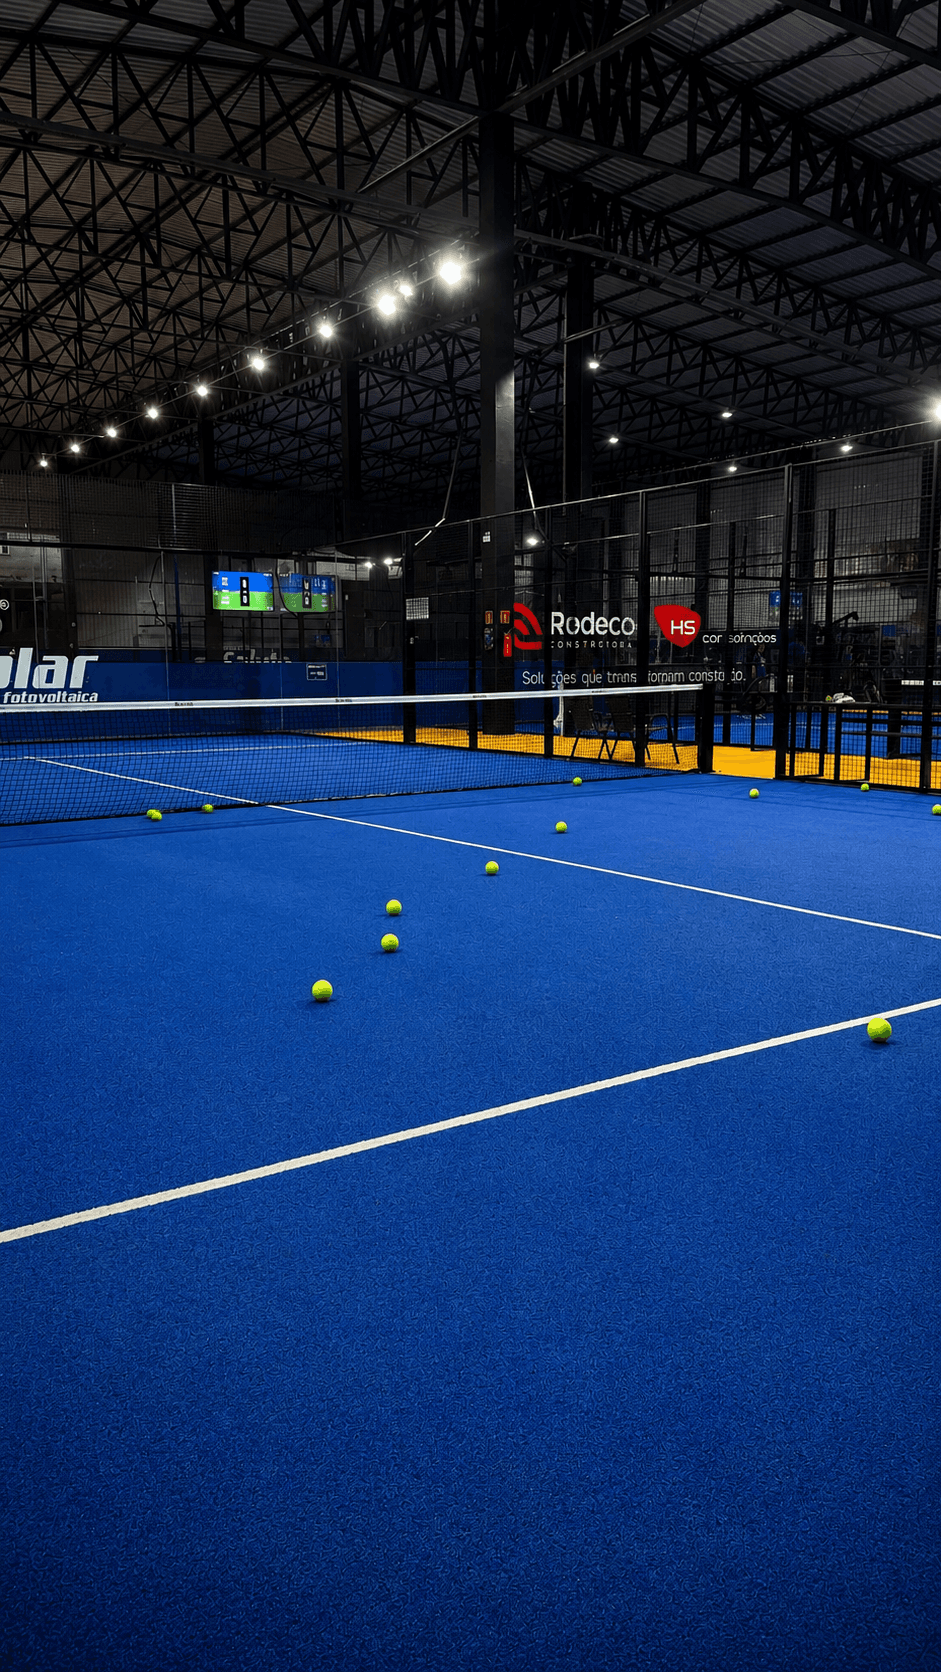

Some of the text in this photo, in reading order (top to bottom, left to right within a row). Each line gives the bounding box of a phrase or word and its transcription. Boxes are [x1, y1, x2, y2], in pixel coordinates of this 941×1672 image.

[551, 611, 636, 635] Rodeco
[670, 619, 696, 635] HS
[522, 670, 577, 688] Soluções
[581, 673, 602, 687] que
[3, 690, 99, 703] fotovoltaica
